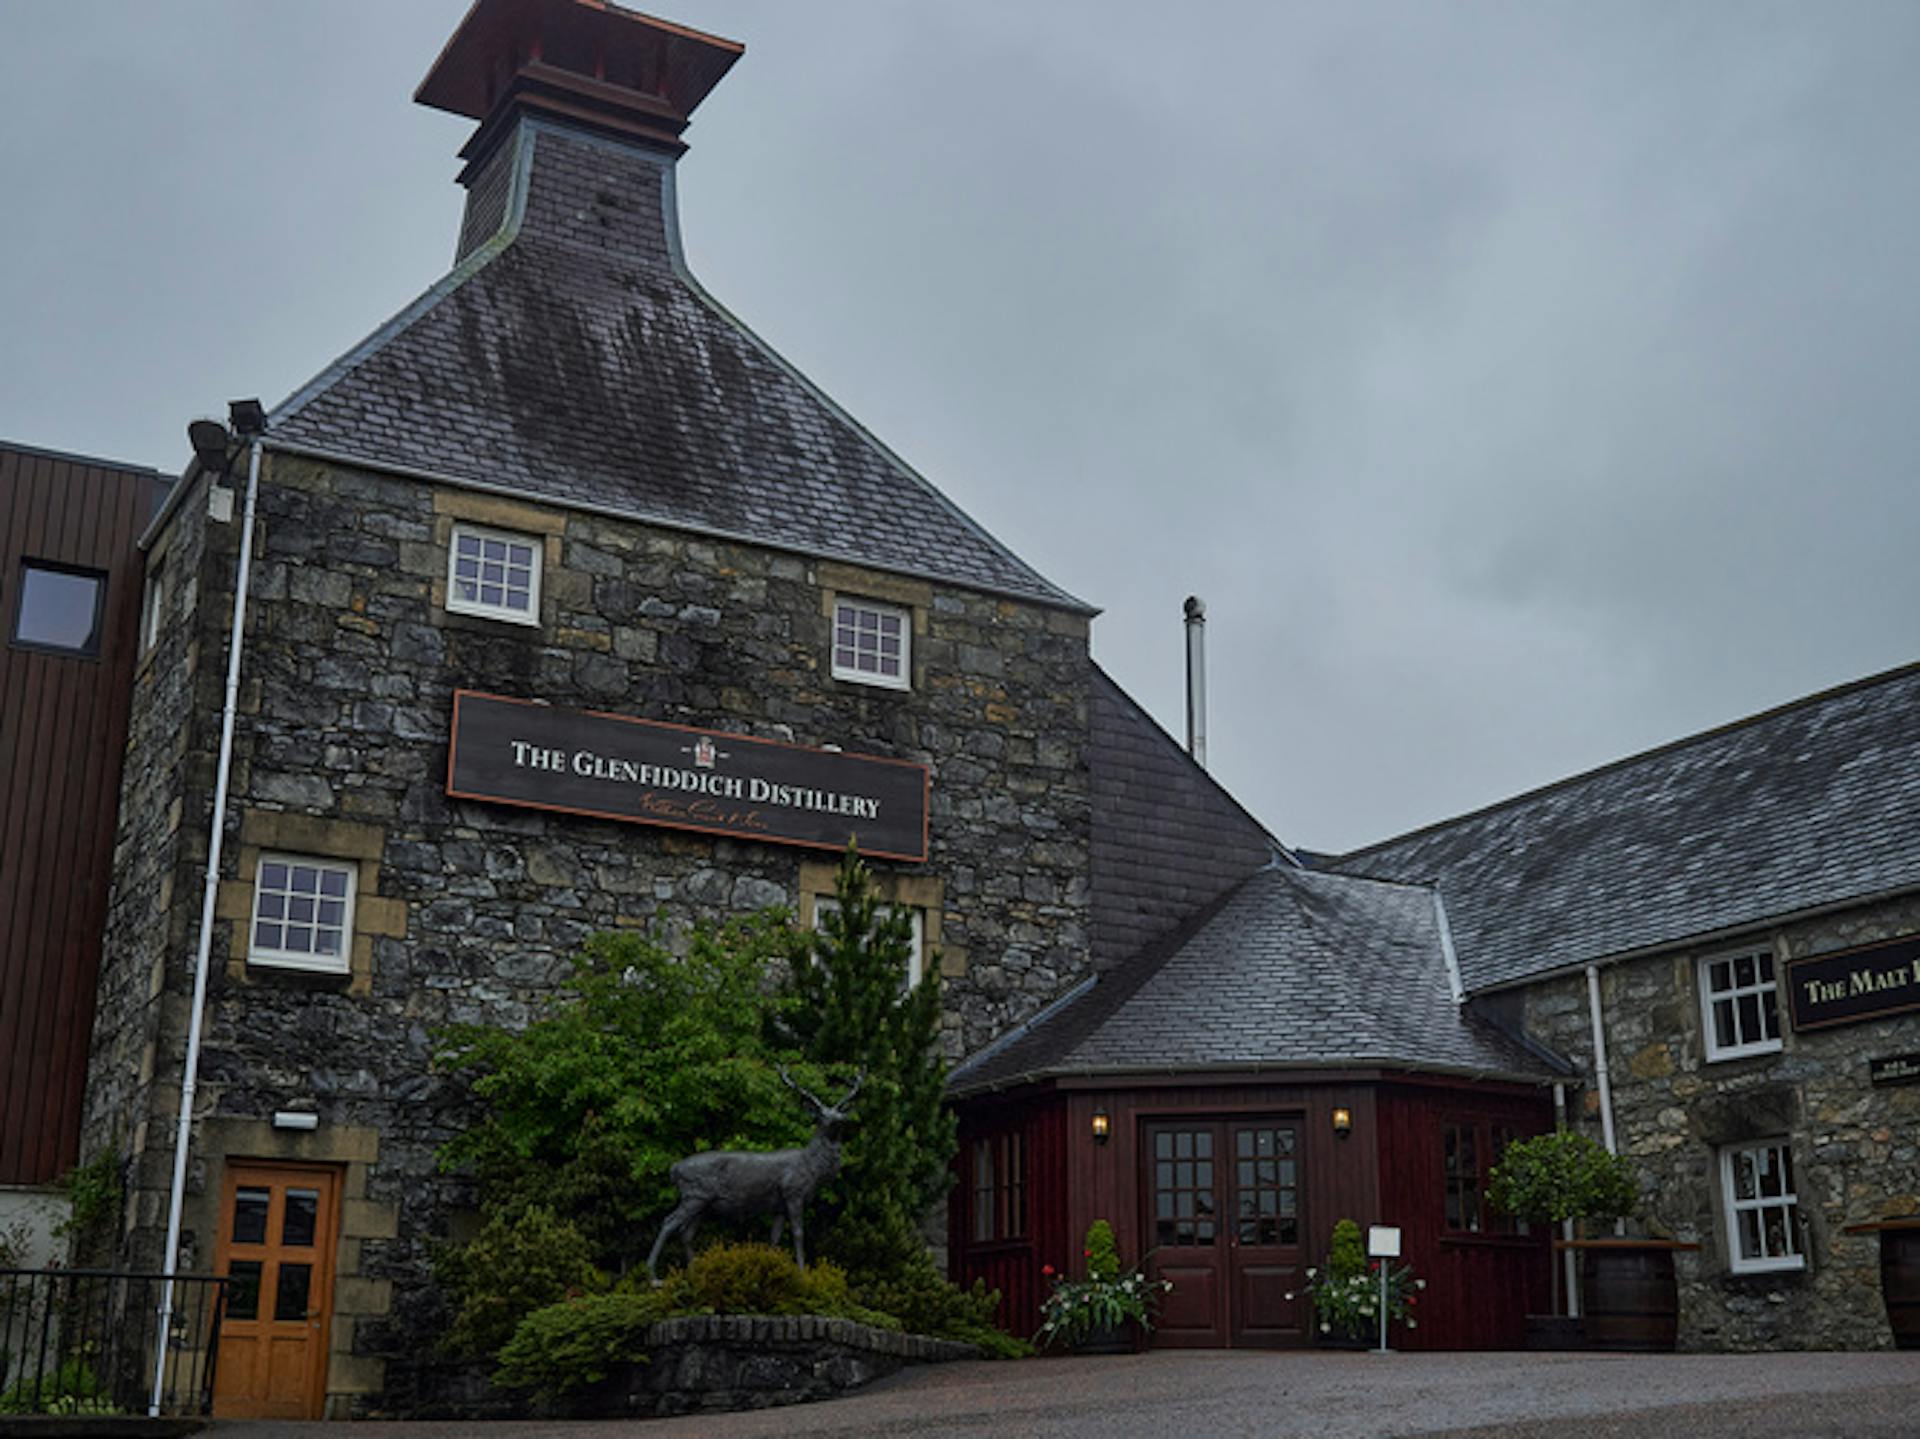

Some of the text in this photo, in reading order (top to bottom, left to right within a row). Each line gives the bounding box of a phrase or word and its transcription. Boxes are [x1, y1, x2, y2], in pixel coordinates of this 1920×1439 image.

[511, 740, 566, 772] THE
[572, 750, 743, 799] GLENFIDDICH
[750, 778, 881, 819] DISTILLERY
[1804, 979, 1846, 1005] THE
[1849, 967, 1909, 997] MALT
